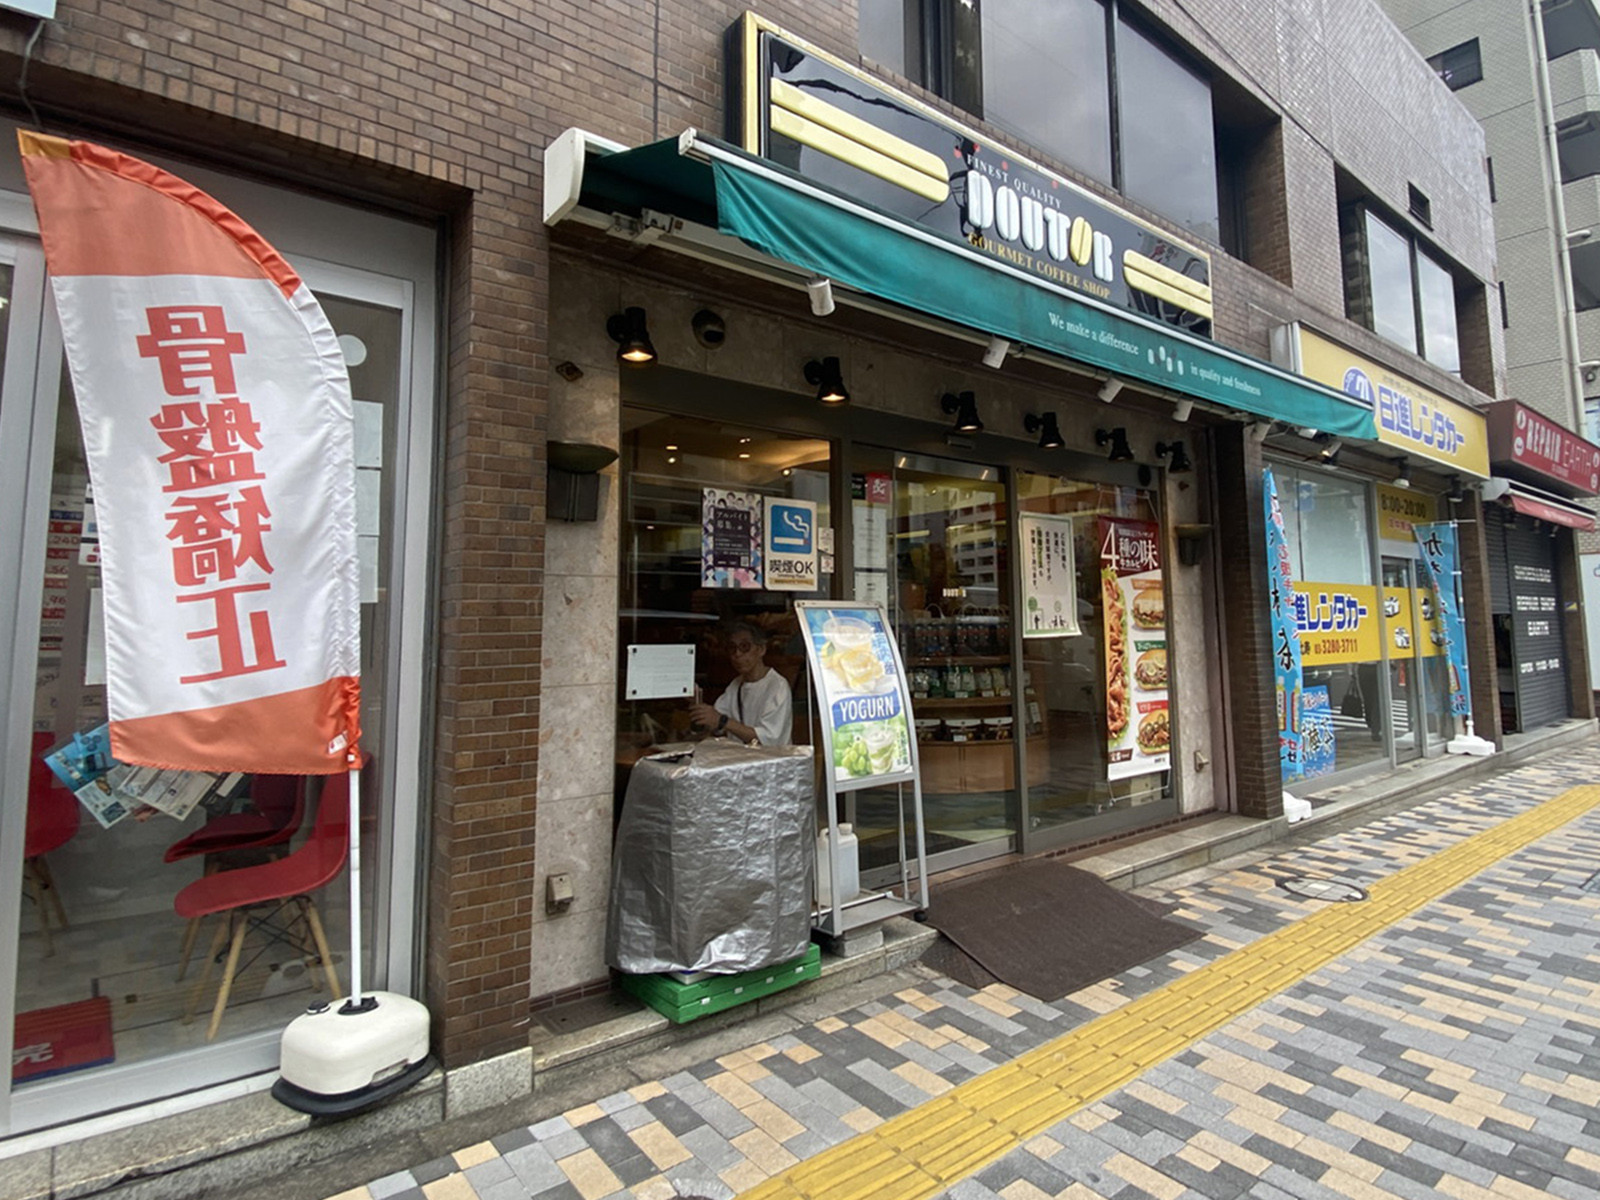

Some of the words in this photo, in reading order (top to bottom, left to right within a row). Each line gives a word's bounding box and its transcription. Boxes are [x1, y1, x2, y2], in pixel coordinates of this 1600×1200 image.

[966, 154, 1009, 184] FINEST
[1013, 178, 1063, 209] QUALITY
[967, 169, 1114, 283] DOUTOR
[967, 231, 1033, 268] GOURMET
[1036, 260, 1081, 289] COFFEE
[1082, 277, 1112, 299] SHOP
[1048, 311, 1065, 330] We
[1066, 320, 1090, 340] make
[1099, 329, 1140, 355] difference
[1199, 366, 1221, 386] quality
[1222, 373, 1234, 388] and
[1378, 383, 1465, 456] 日進レンタカー
[1526, 418, 1562, 463] REPAIR
[769, 559, 814, 575] 喫煙OK
[1100, 522, 1159, 570] 4種の味
[839, 695, 895, 722] YOGURN
